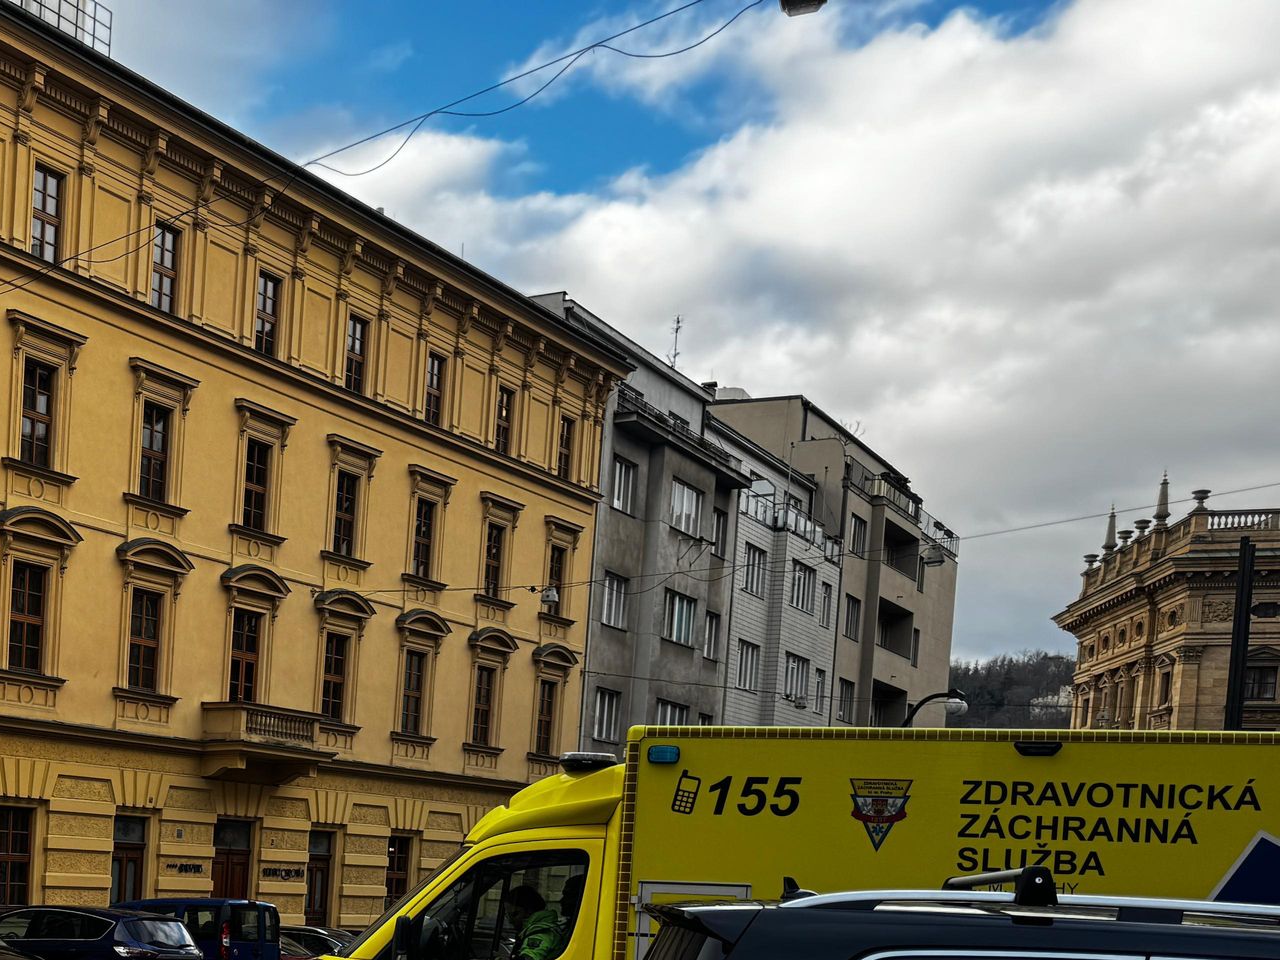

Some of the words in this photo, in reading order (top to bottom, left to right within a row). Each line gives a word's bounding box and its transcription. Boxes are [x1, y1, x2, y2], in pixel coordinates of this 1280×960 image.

[708, 776, 802, 817] 155
[959, 779, 1262, 812] ZDRAVOTNICKÁ
[957, 812, 1198, 845] ZÁCHRANNÁ
[956, 842, 1104, 876] SLUŽBA
